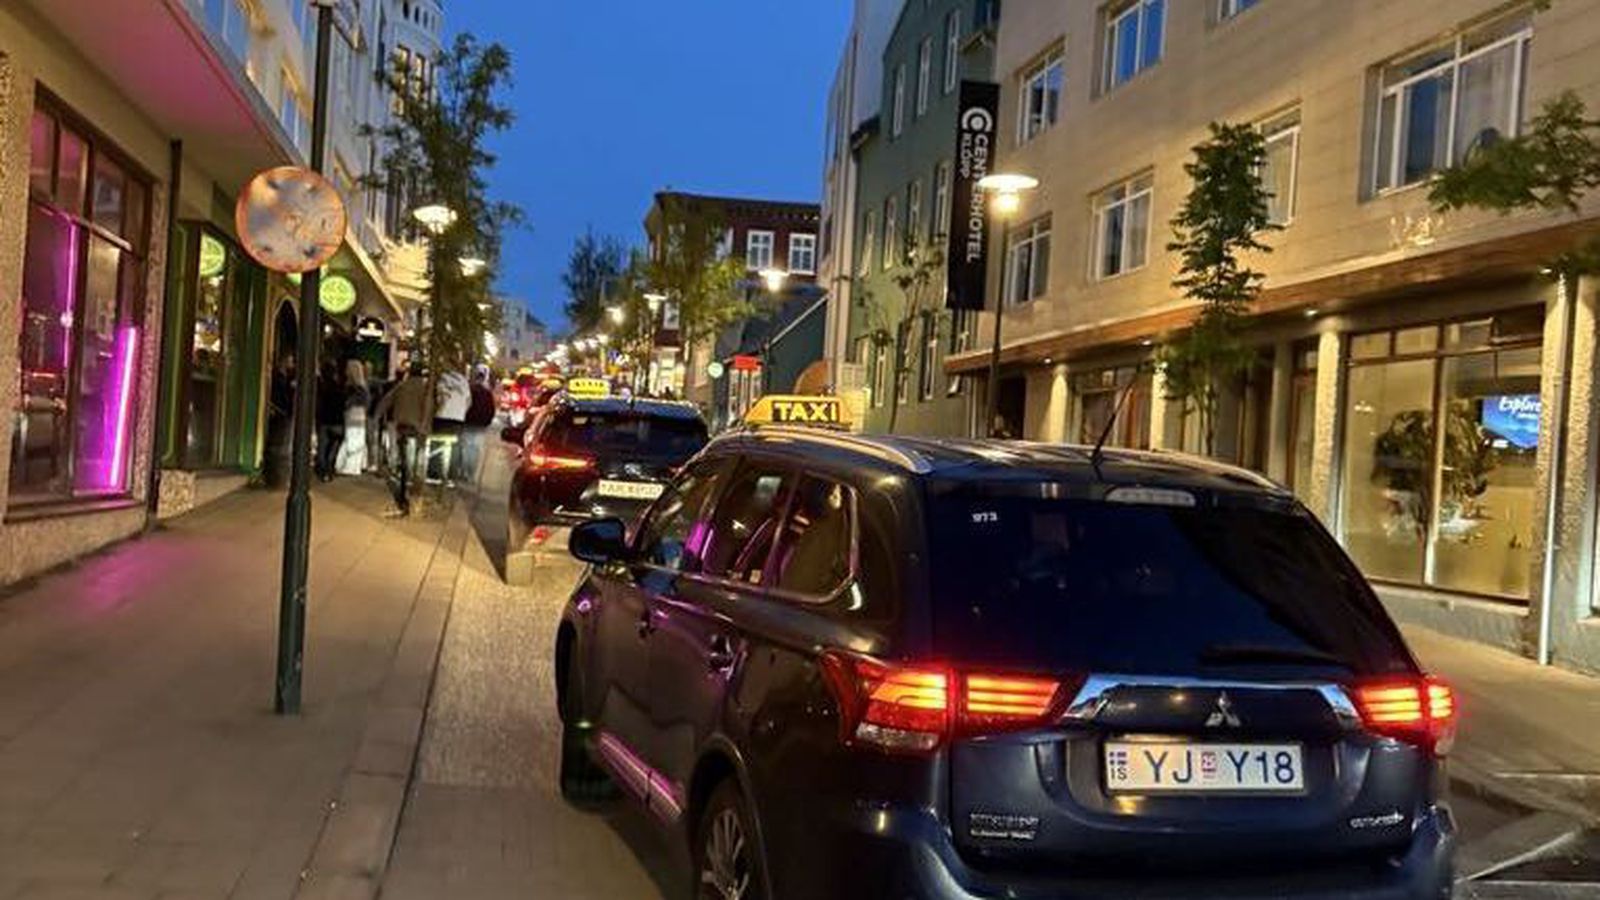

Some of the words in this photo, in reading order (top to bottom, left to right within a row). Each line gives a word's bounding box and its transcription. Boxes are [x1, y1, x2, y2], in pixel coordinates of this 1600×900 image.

[966, 134, 989, 263] CENTERHOTEL
[774, 402, 837, 421] TAXI
[1110, 767, 1128, 781] IS
[1144, 751, 1193, 783] YJ
[1226, 751, 1295, 784] Y18
